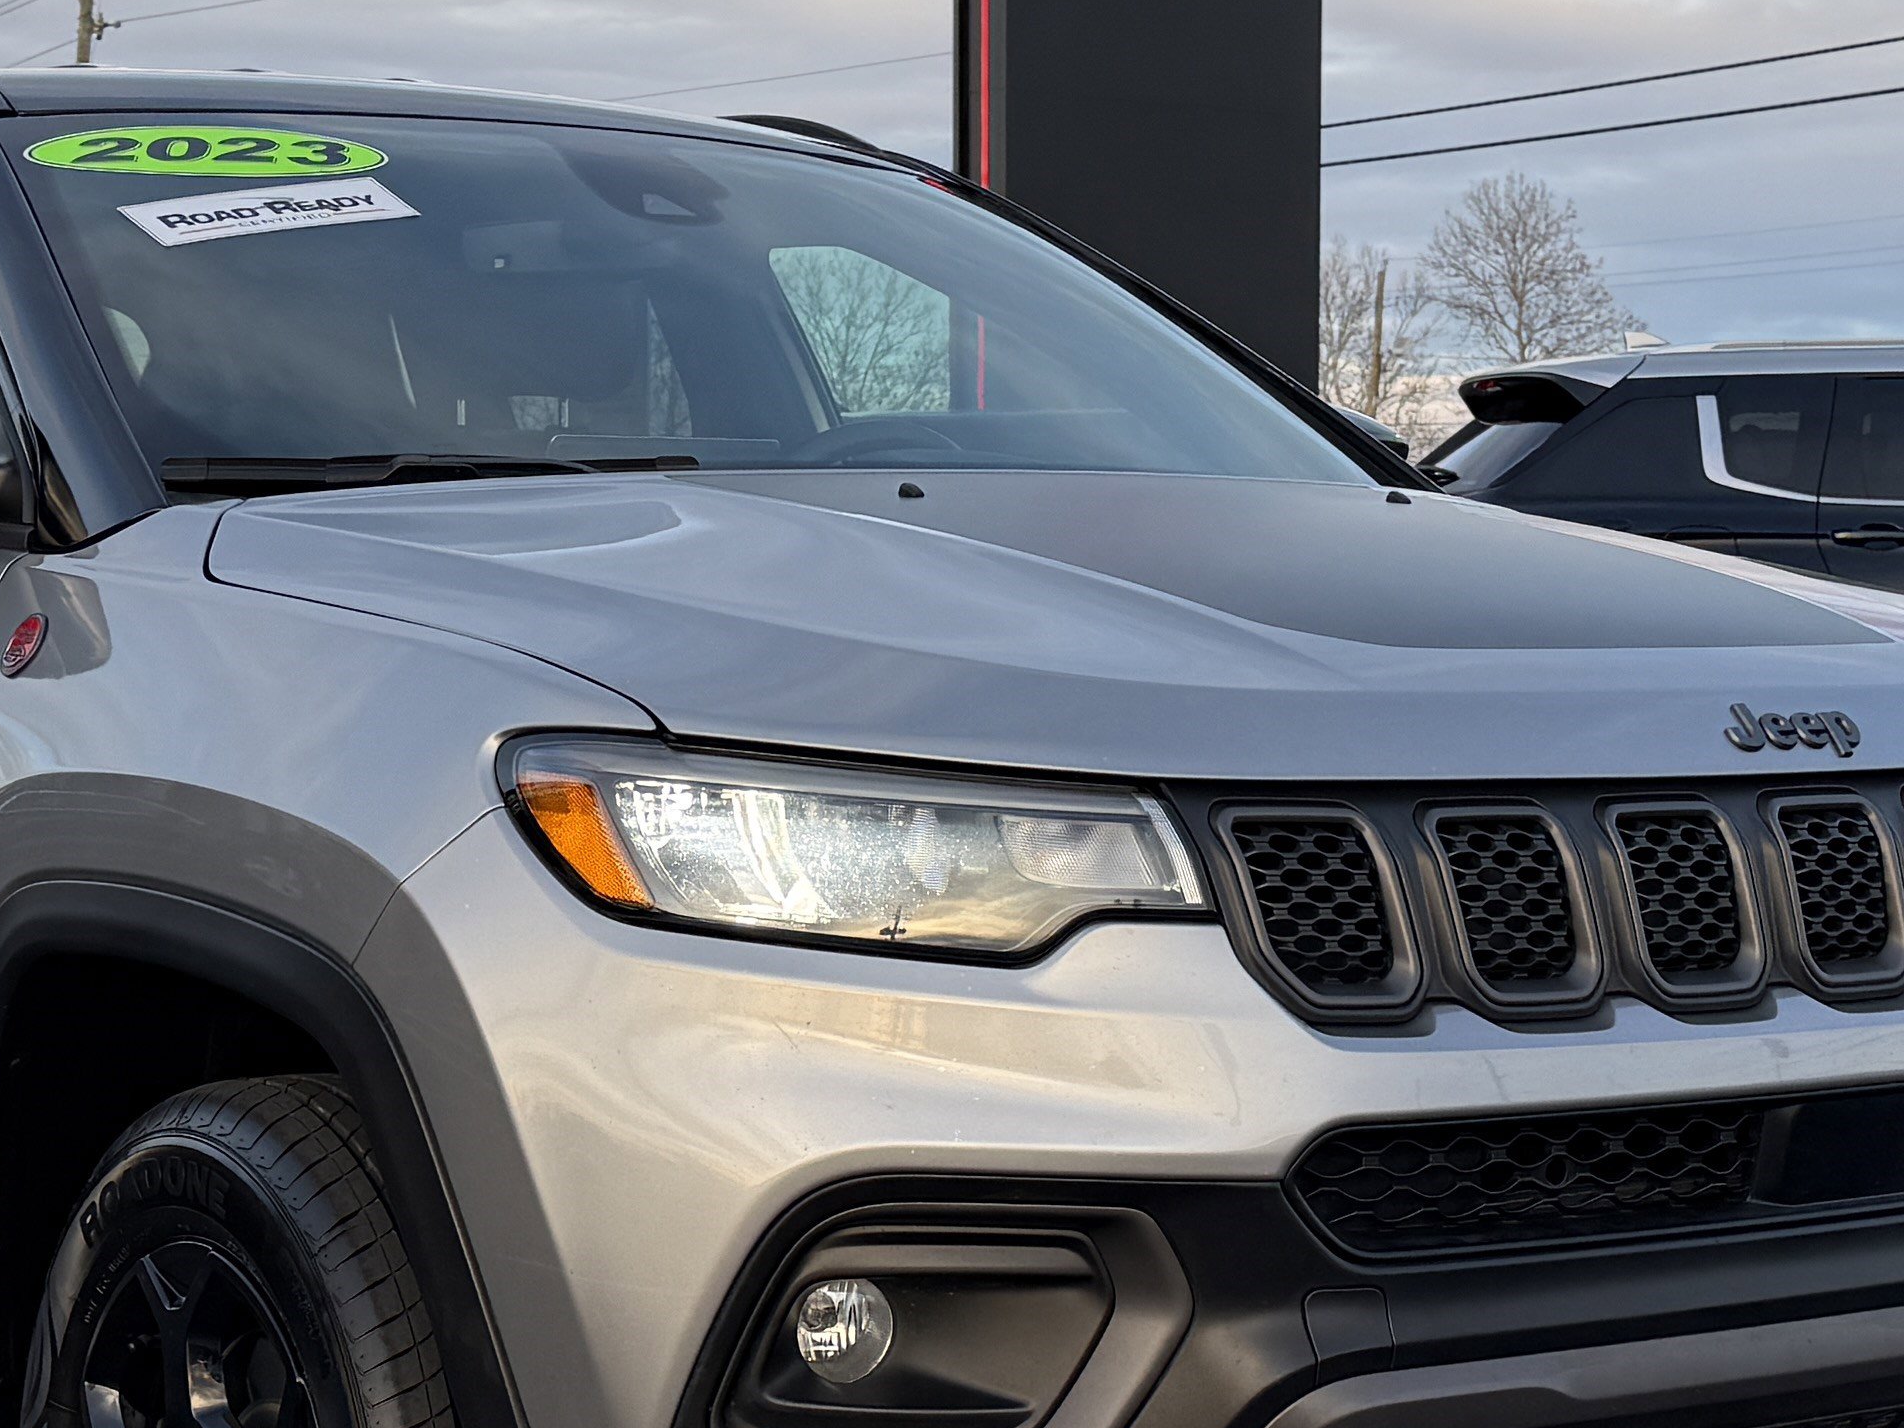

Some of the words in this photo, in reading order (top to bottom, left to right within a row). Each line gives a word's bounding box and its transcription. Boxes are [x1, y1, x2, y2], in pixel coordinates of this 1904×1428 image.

[71, 136, 351, 166] 2023
[157, 206, 259, 229] ROAD
[263, 193, 373, 214] READY
[1723, 702, 1861, 758] Jeep
